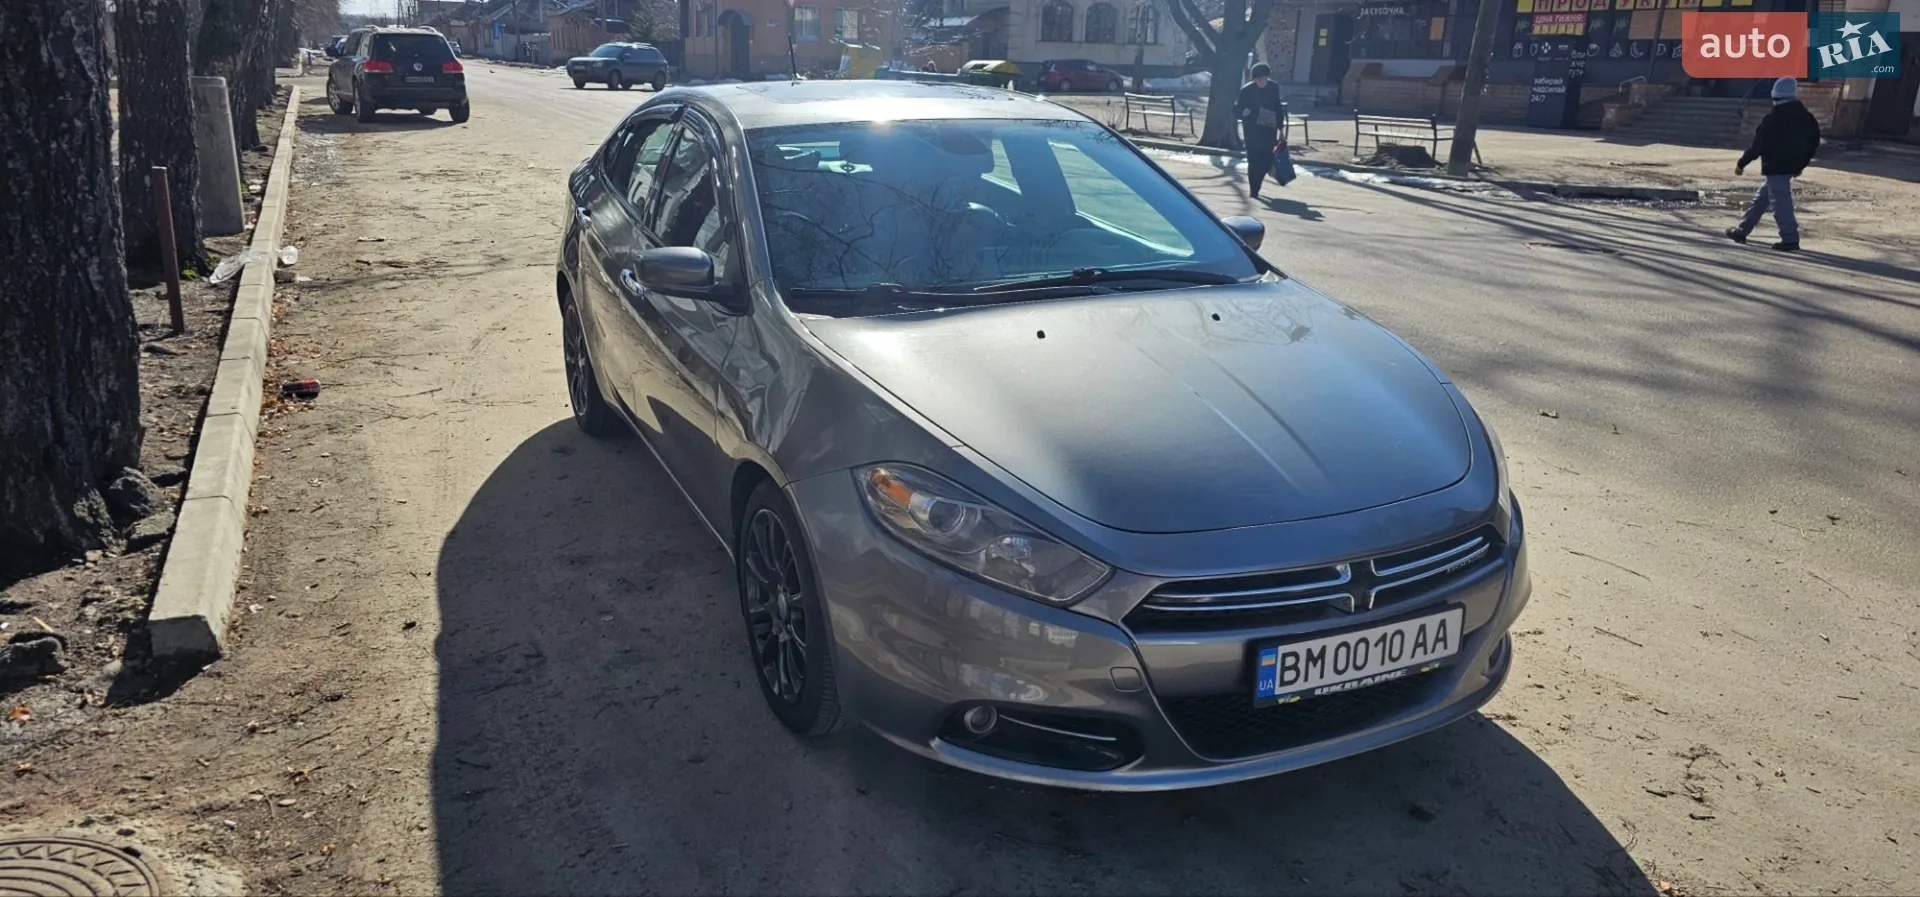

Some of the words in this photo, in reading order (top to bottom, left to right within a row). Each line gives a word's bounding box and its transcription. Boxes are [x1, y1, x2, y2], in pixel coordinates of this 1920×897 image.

[1530, 94, 1546, 102] 24/7
[1279, 645, 1327, 687] BM
[1333, 629, 1405, 675] 0010
[1411, 618, 1449, 660] AA
[1259, 679, 1274, 691] UA
[1314, 669, 1408, 695] UKRAINE
